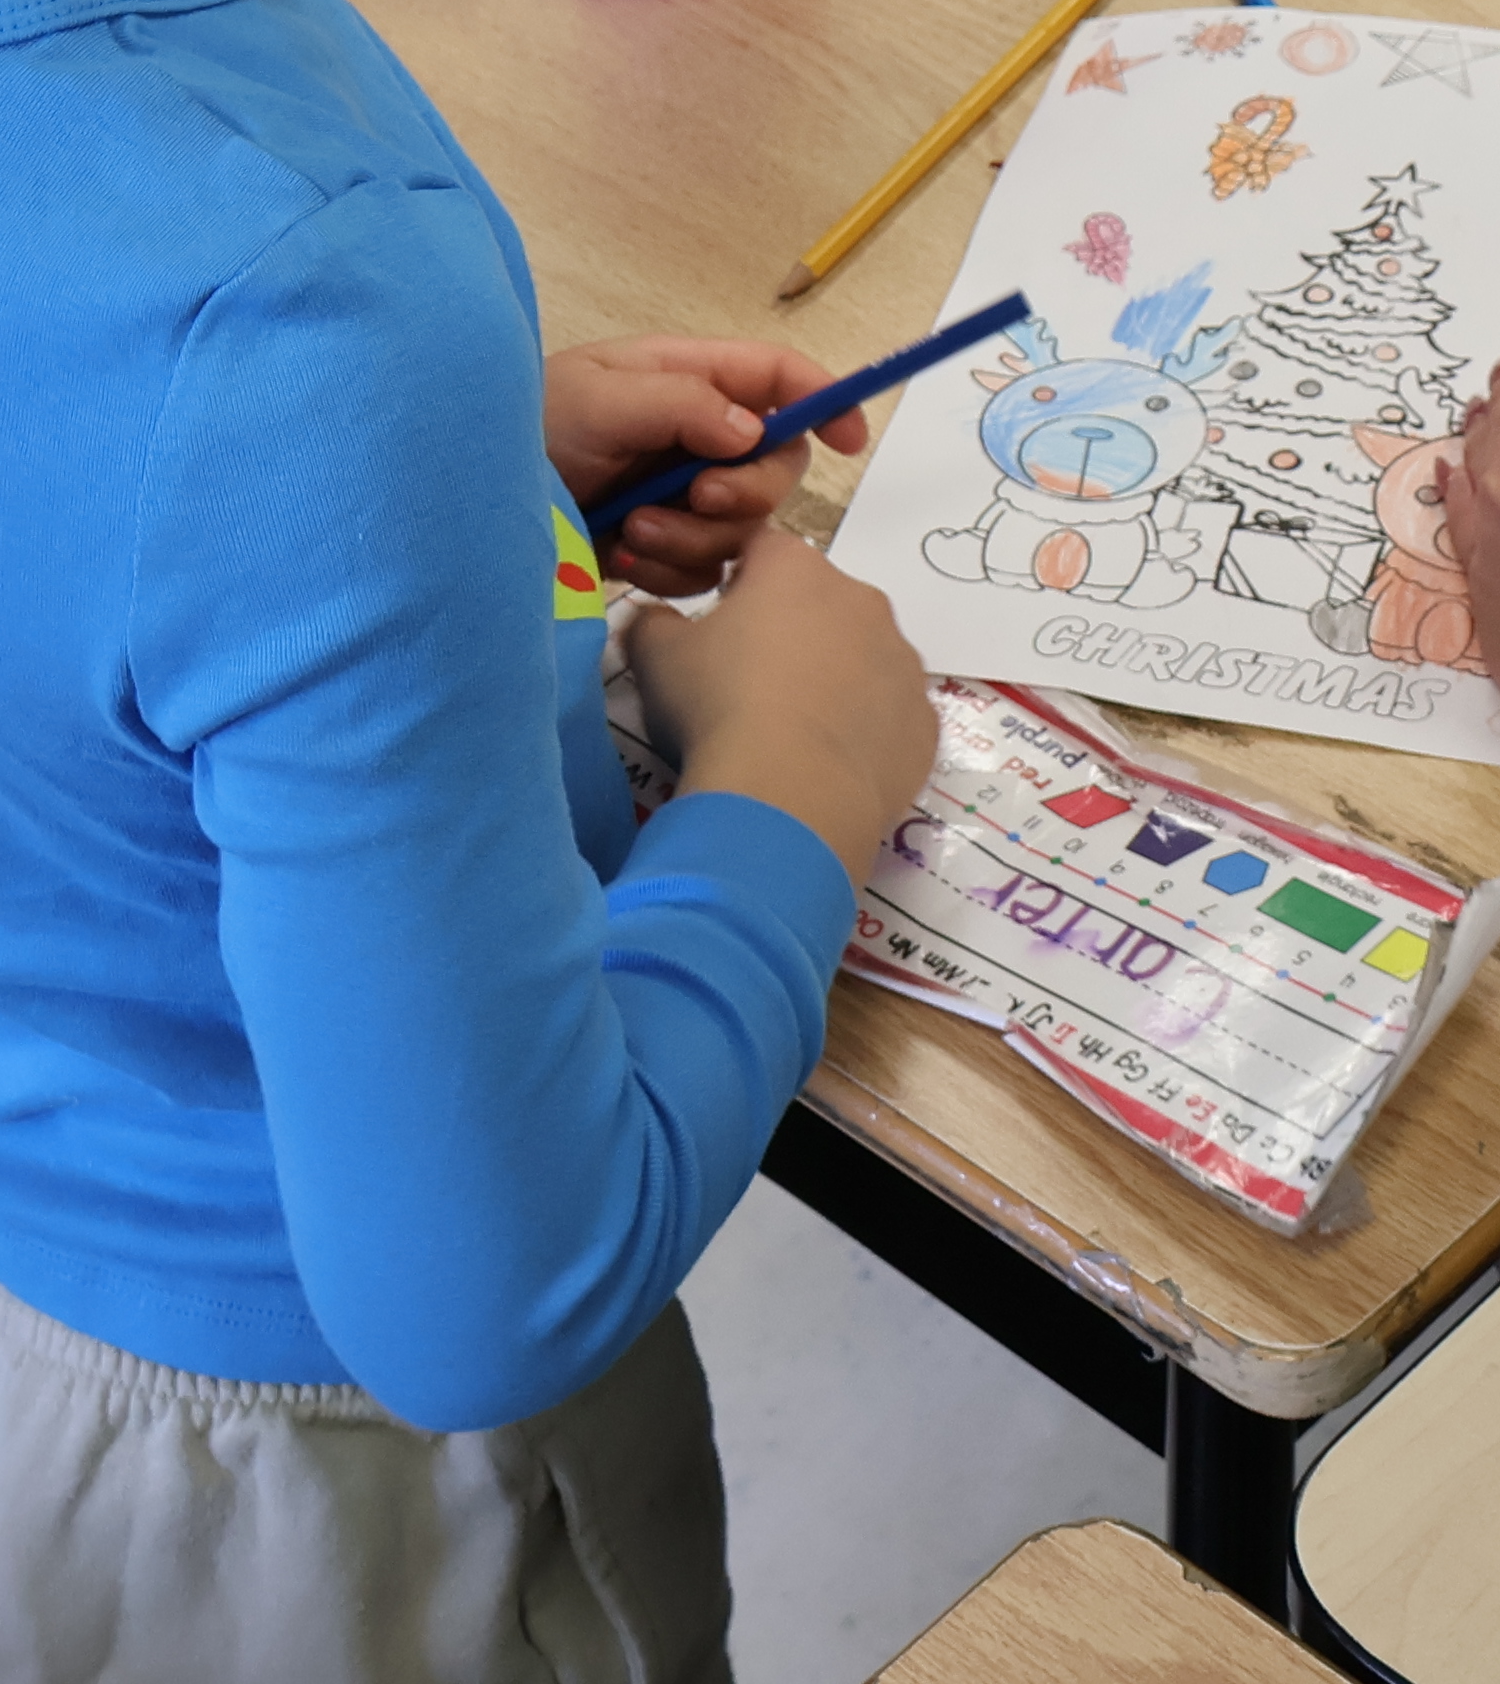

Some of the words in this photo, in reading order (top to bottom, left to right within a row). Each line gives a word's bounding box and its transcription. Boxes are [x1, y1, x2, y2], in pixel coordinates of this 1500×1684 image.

[1032, 614, 1453, 723] CHRISTMAS
[999, 714, 1089, 769] purple
[1002, 755, 1054, 790] red
[976, 784, 1003, 805] 12
[1022, 814, 1044, 831] 11
[1063, 836, 1088, 855] 10
[1109, 858, 1126, 877] 9
[1153, 877, 1176, 896] 8
[1197, 901, 1219, 919] 7
[1249, 922, 1266, 939] 6
[885, 930, 918, 962] Nn
[968, 872, 1232, 1047] Carter
[1292, 948, 1313, 968] 5
[922, 951, 967, 989] Mm
[1021, 1000, 1055, 1031] Jj
[1077, 1032, 1115, 1064] Hh
[1114, 1048, 1150, 1083] Gg
[1147, 1076, 1184, 1103] Ff
[1185, 1093, 1219, 1122] Ee
